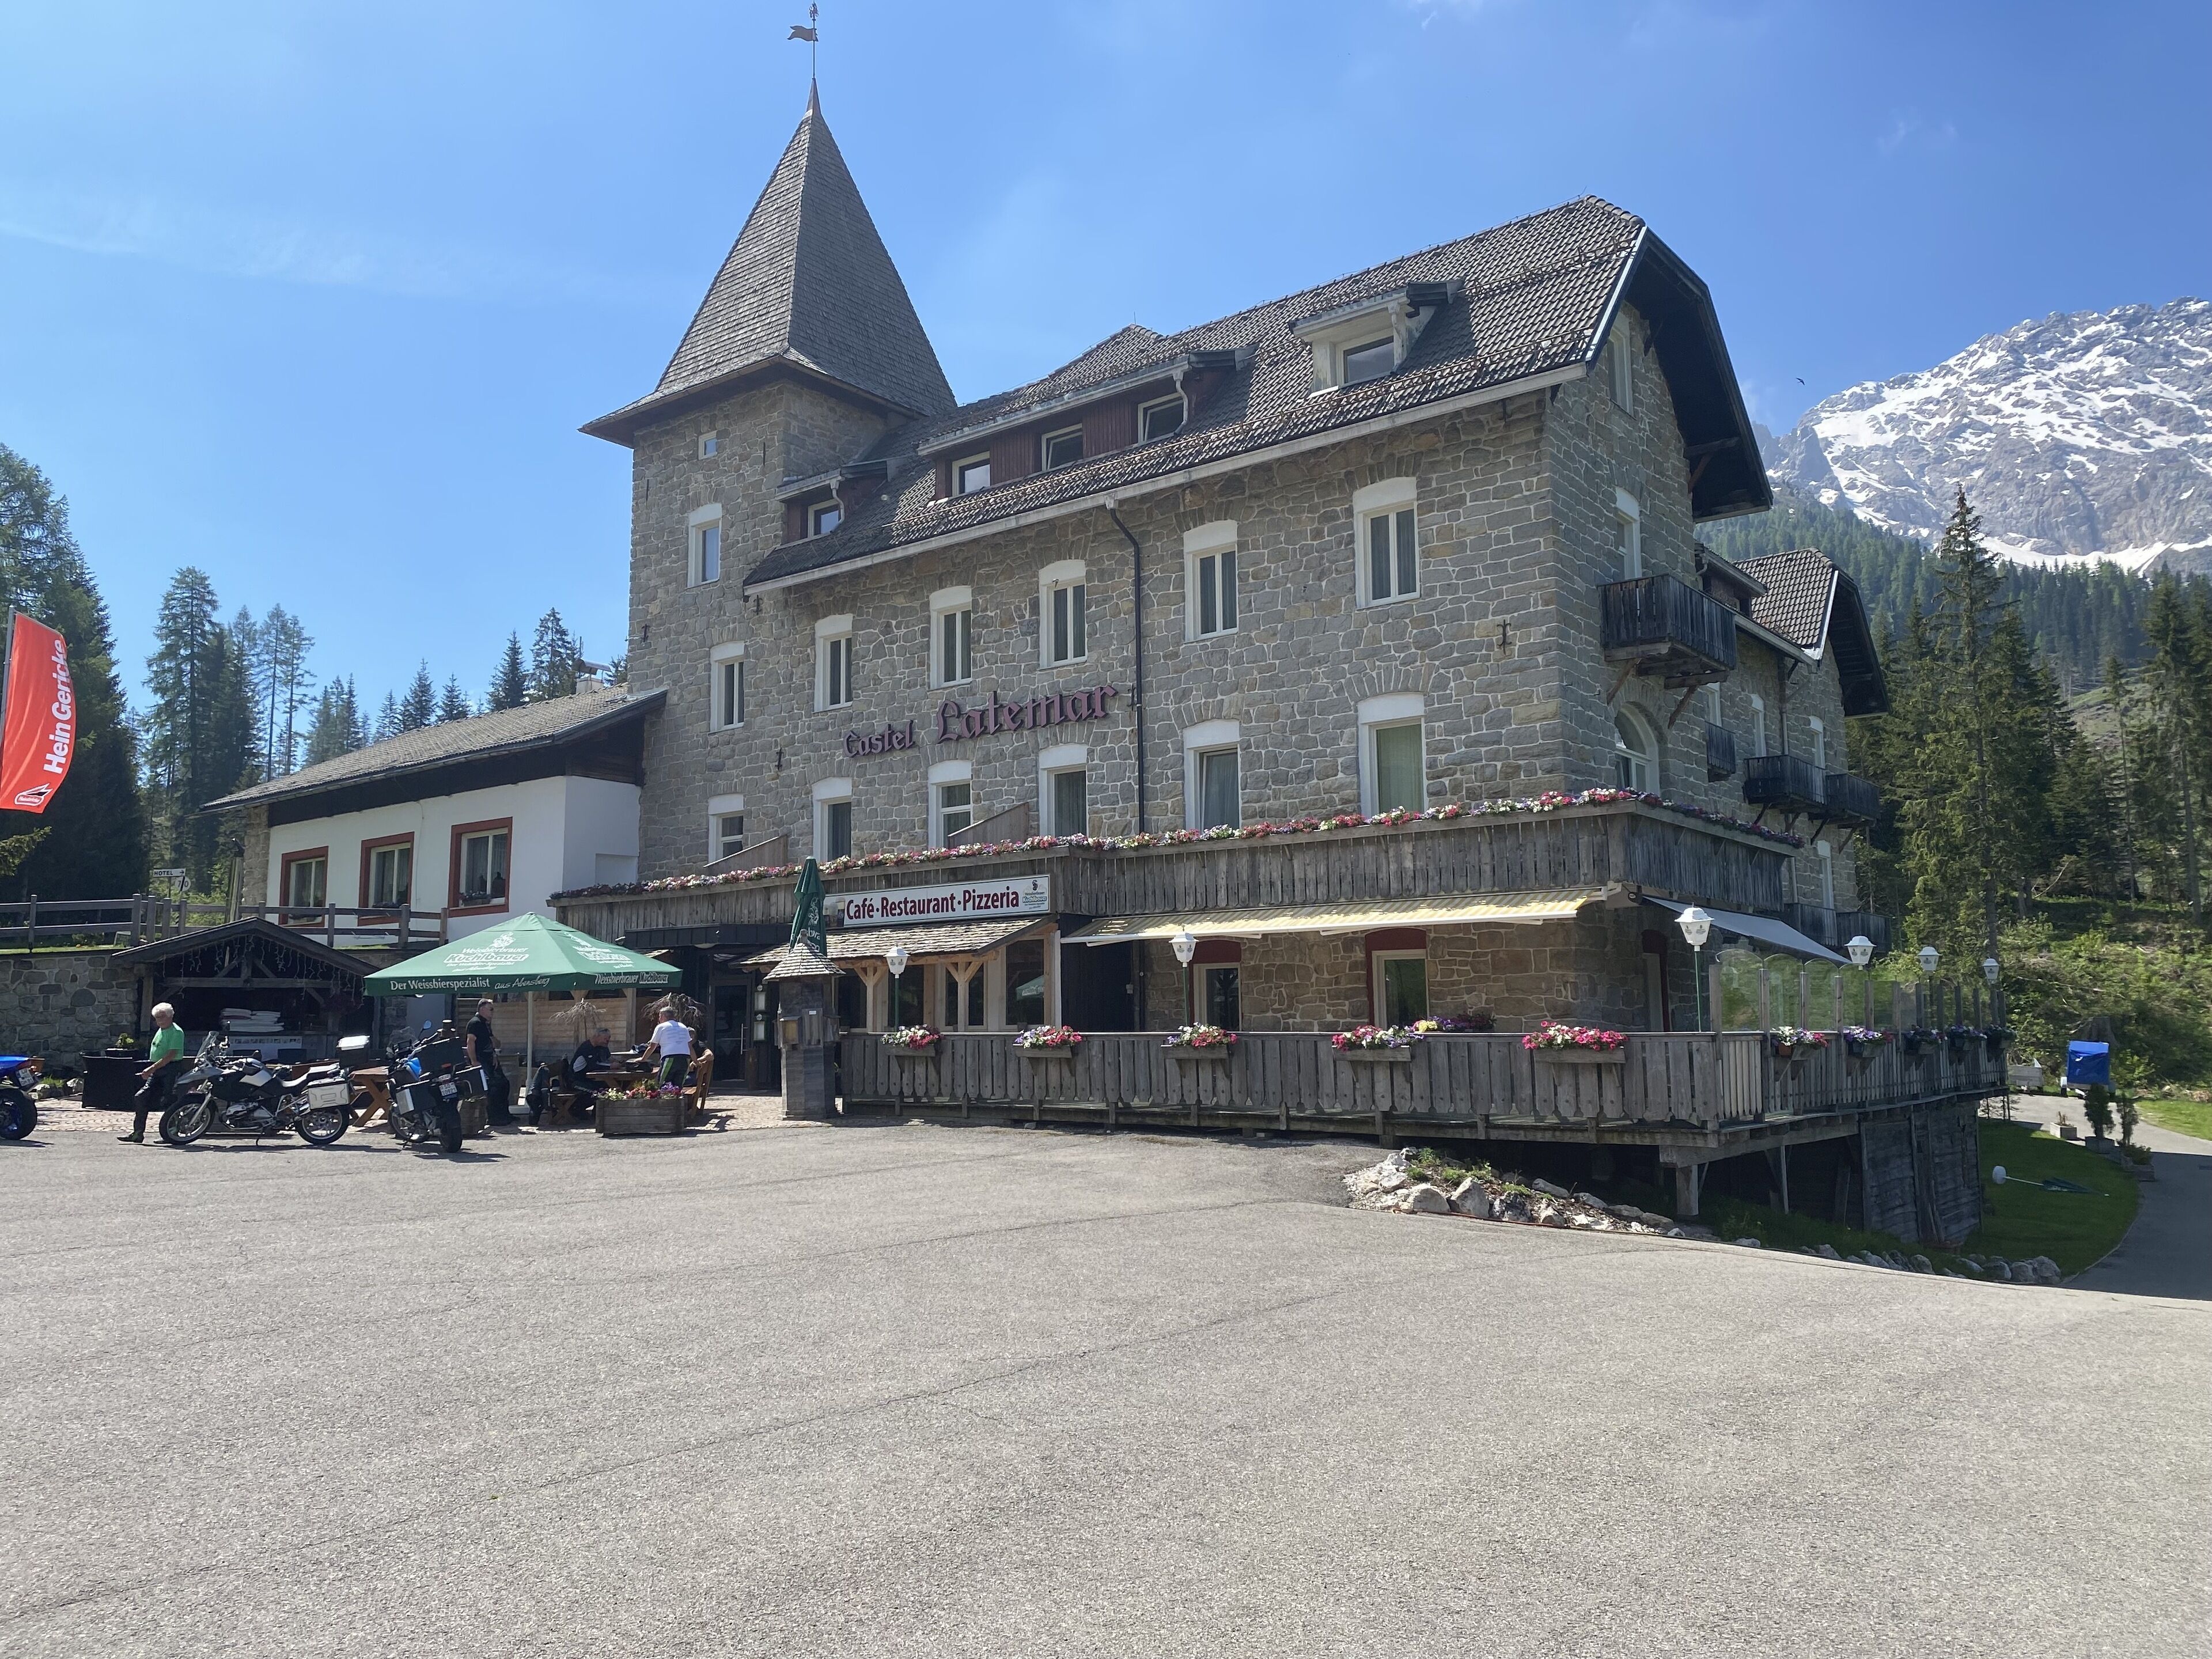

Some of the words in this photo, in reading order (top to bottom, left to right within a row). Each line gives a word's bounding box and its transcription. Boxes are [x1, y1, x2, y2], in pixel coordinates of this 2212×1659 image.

[52, 639, 72, 721] Gericke
[843, 720, 915, 757] Castel
[936, 684, 1117, 744] Latemar
[43, 722, 71, 774] Hein
[846, 897, 874, 920] Café
[881, 893, 956, 918] Restaurant
[963, 885, 1019, 911] Pizzeria
[444, 952, 529, 963] Kuchlbauer
[391, 980, 407, 990] Der
[408, 978, 491, 991] Weissbierspezialist
[512, 975, 550, 987] Abensberg
